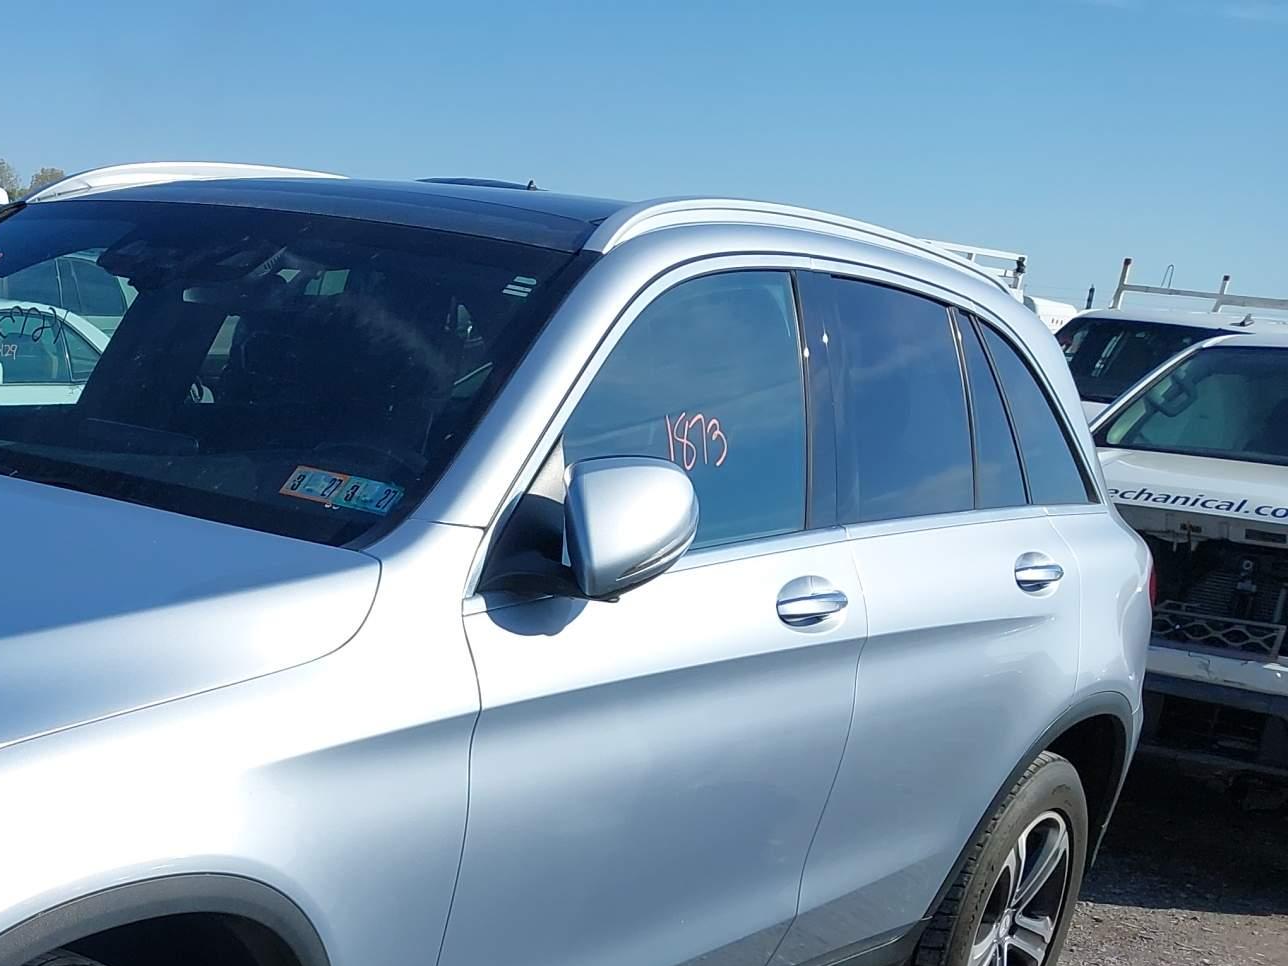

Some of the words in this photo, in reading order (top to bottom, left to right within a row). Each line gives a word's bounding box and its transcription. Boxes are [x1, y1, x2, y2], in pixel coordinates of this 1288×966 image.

[665, 411, 728, 471] 1873
[290, 474, 306, 491] 3
[320, 478, 343, 499] 27
[344, 484, 360, 501] 3
[375, 489, 398, 508] 27
